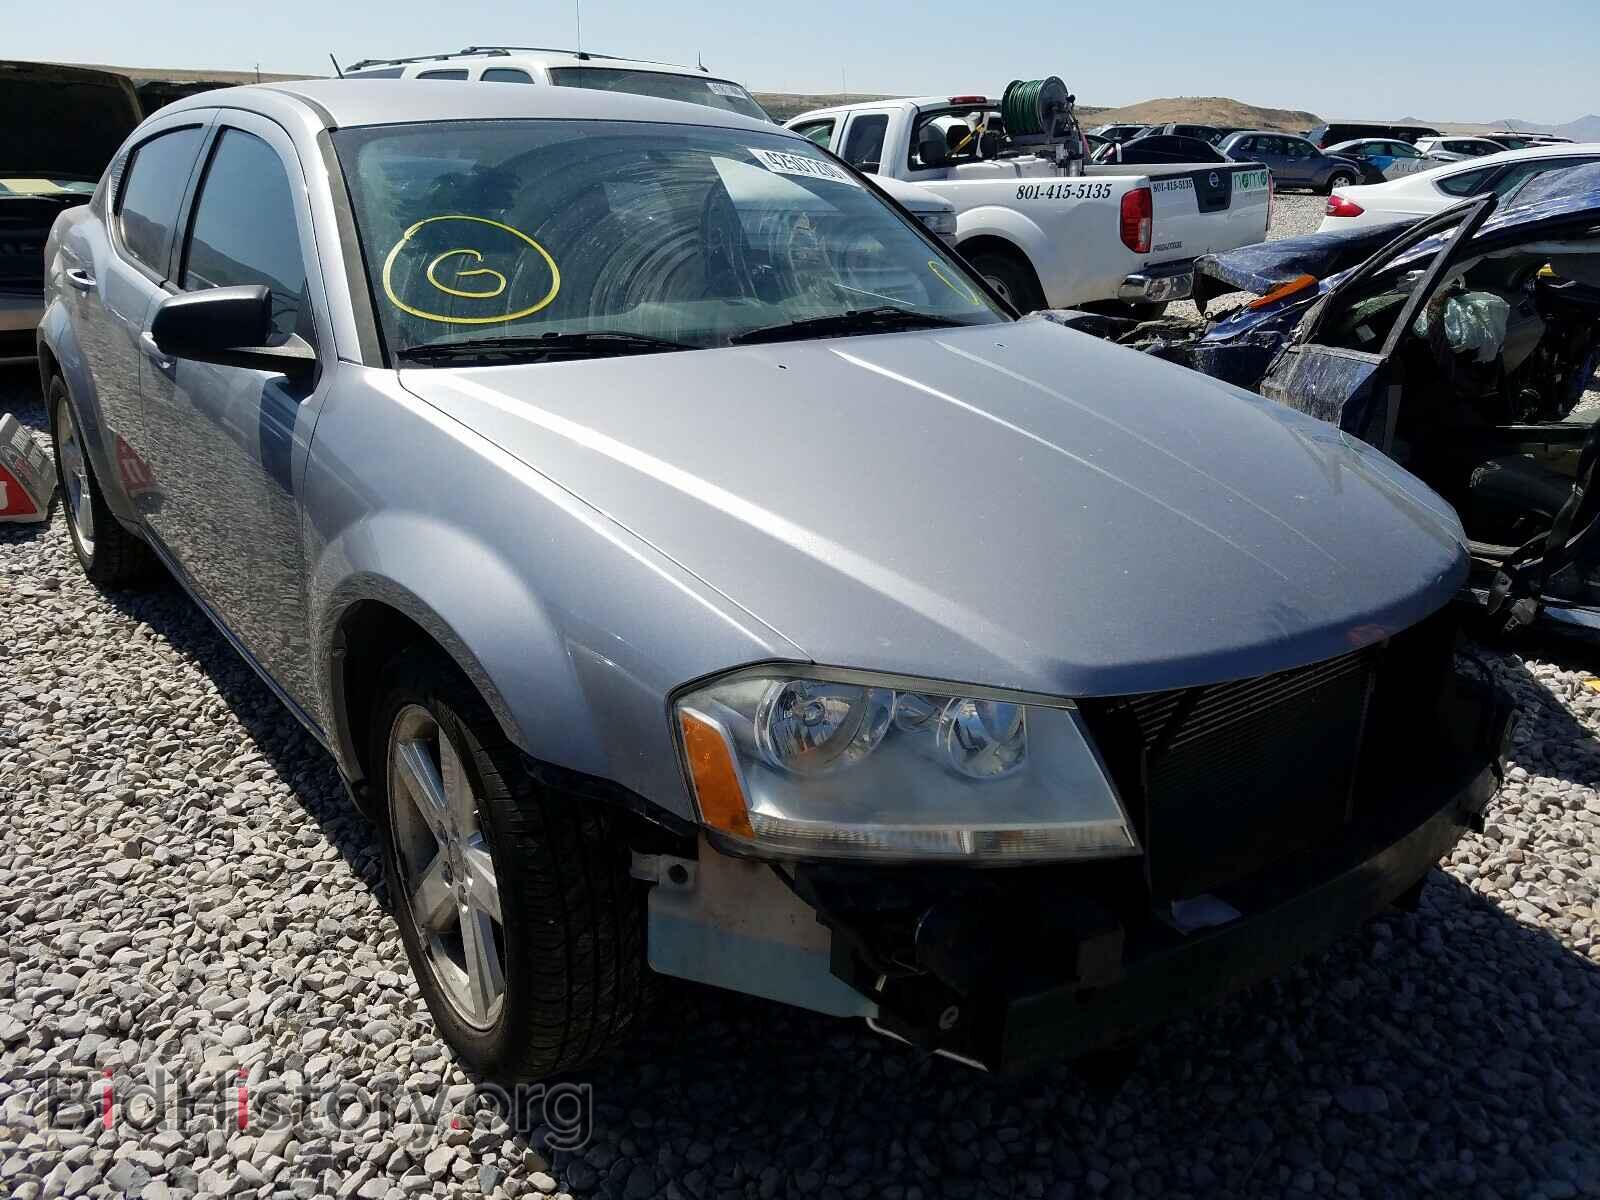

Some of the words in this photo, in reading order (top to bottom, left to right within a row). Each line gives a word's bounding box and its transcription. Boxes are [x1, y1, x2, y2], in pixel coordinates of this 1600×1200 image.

[1016, 183, 1113, 200] 801-415-5135
[1152, 179, 1194, 193] 801-415-5135
[426, 248, 507, 298] G
